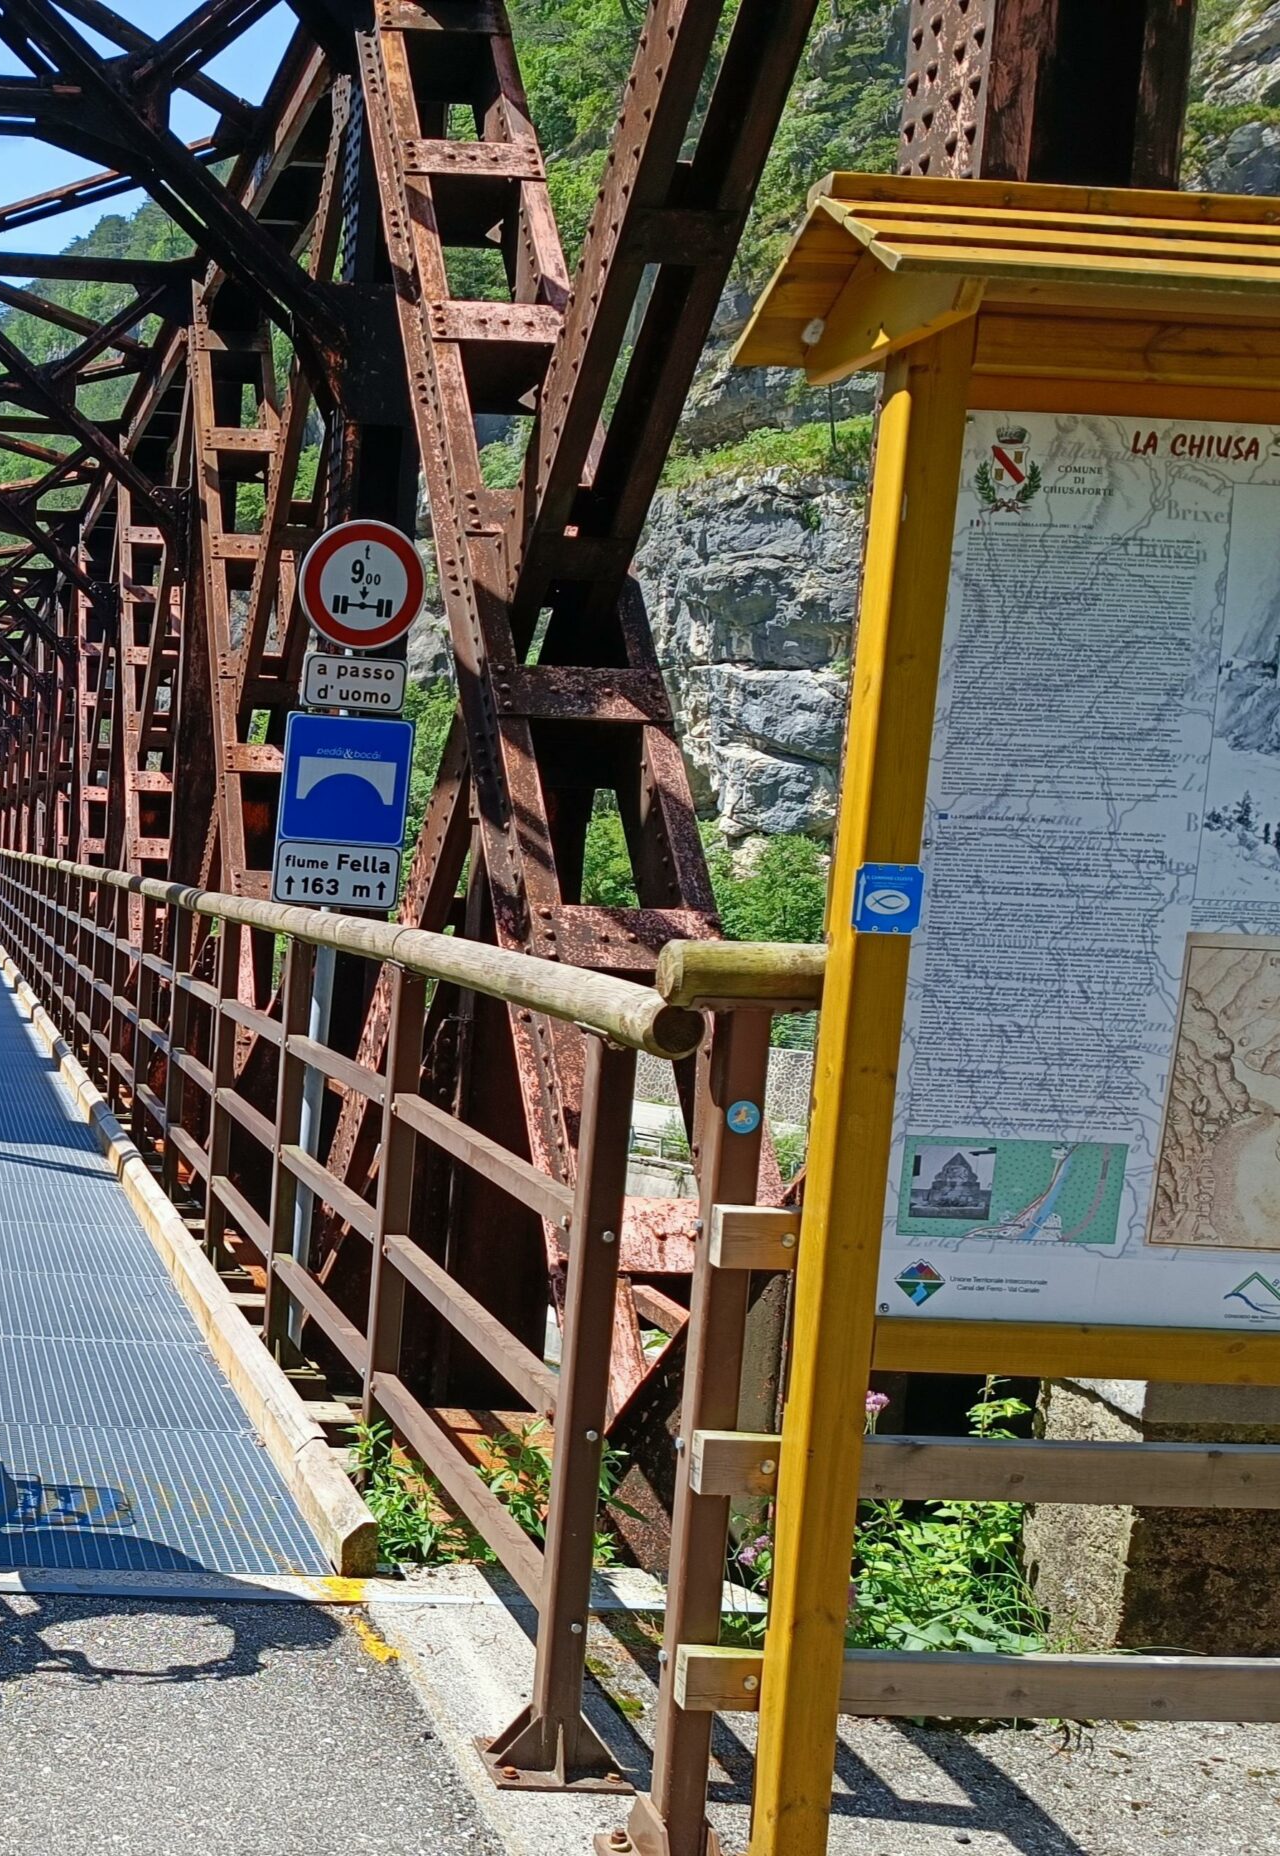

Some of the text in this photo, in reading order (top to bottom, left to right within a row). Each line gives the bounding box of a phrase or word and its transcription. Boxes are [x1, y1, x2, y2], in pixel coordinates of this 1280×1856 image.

[1131, 430, 1158, 455] LA
[1170, 433, 1260, 461] CHIUSA
[1057, 464, 1103, 475] COMUNE
[1074, 476, 1085, 485] DI
[1043, 485, 1114, 497] CHIUSAFORTE
[365, 544, 371, 560] t
[317, 663, 395, 681] a passo
[285, 853, 391, 874] fiume Fella
[301, 876, 371, 898] 163 m
